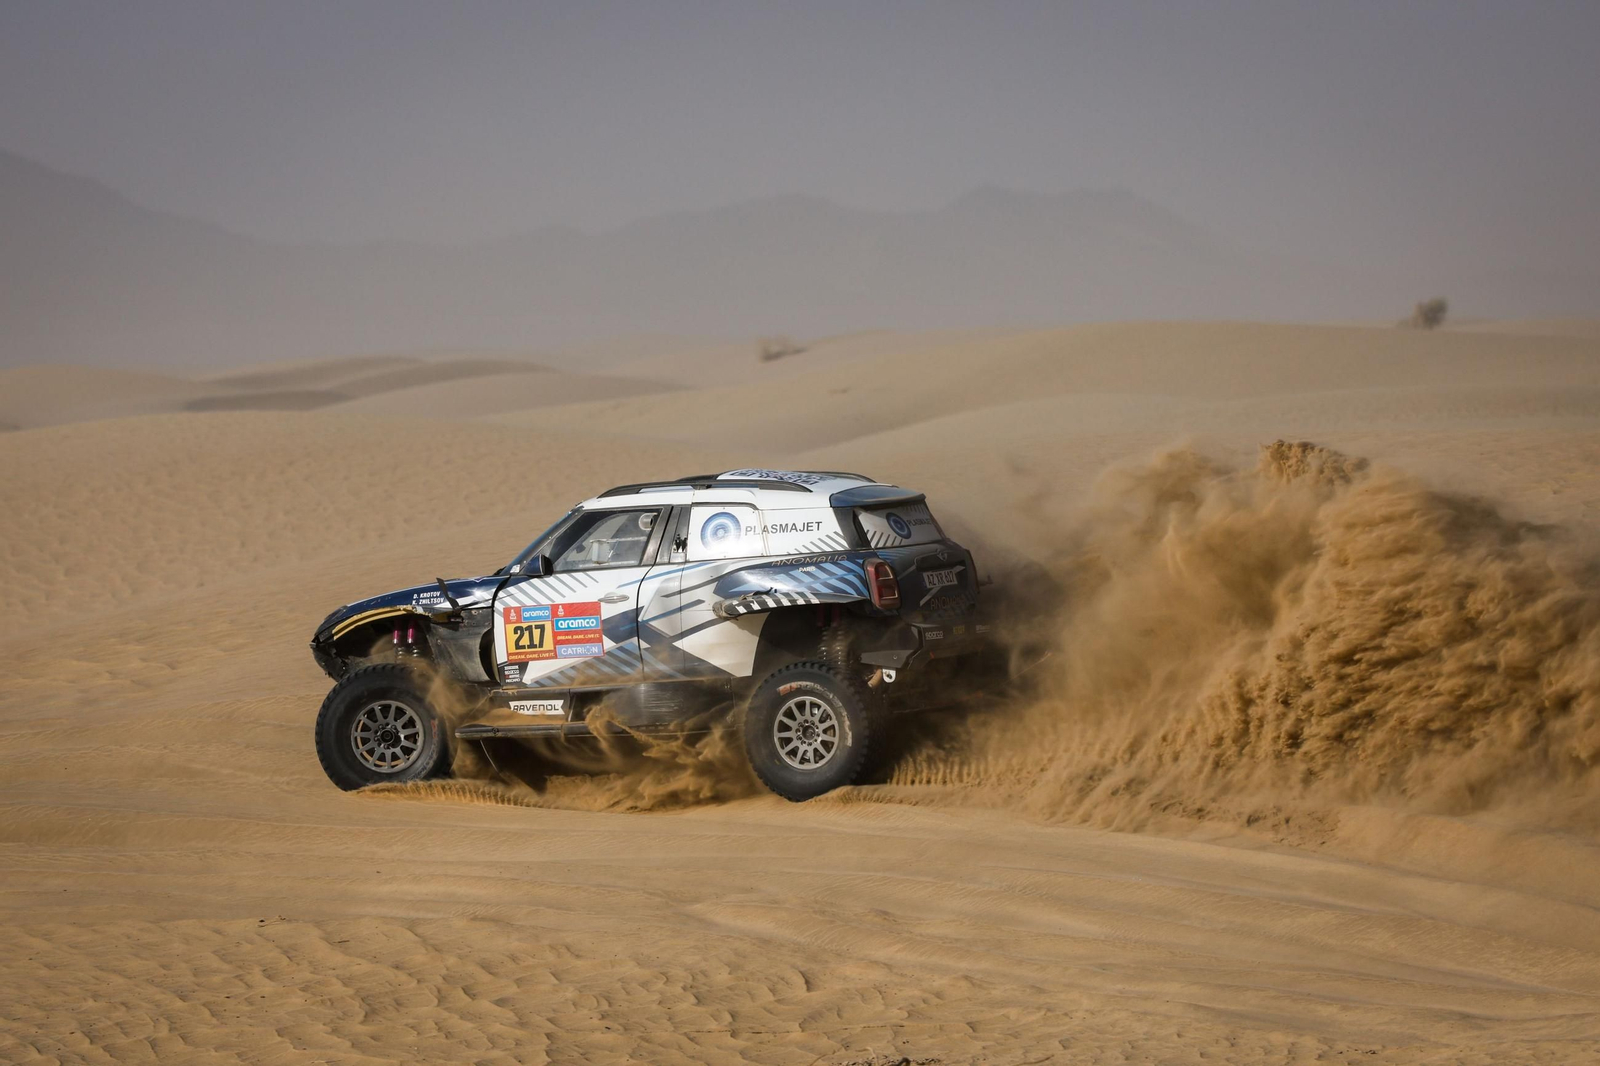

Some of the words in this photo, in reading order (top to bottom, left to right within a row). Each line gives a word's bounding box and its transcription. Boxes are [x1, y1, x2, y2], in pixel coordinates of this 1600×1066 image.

[744, 521, 823, 536] PLASMAJET
[771, 554, 848, 567] ANOMALIA
[523, 610, 549, 618] aramco
[558, 618, 596, 628] aramco
[513, 624, 546, 650] 217
[561, 646, 598, 655] CATRION
